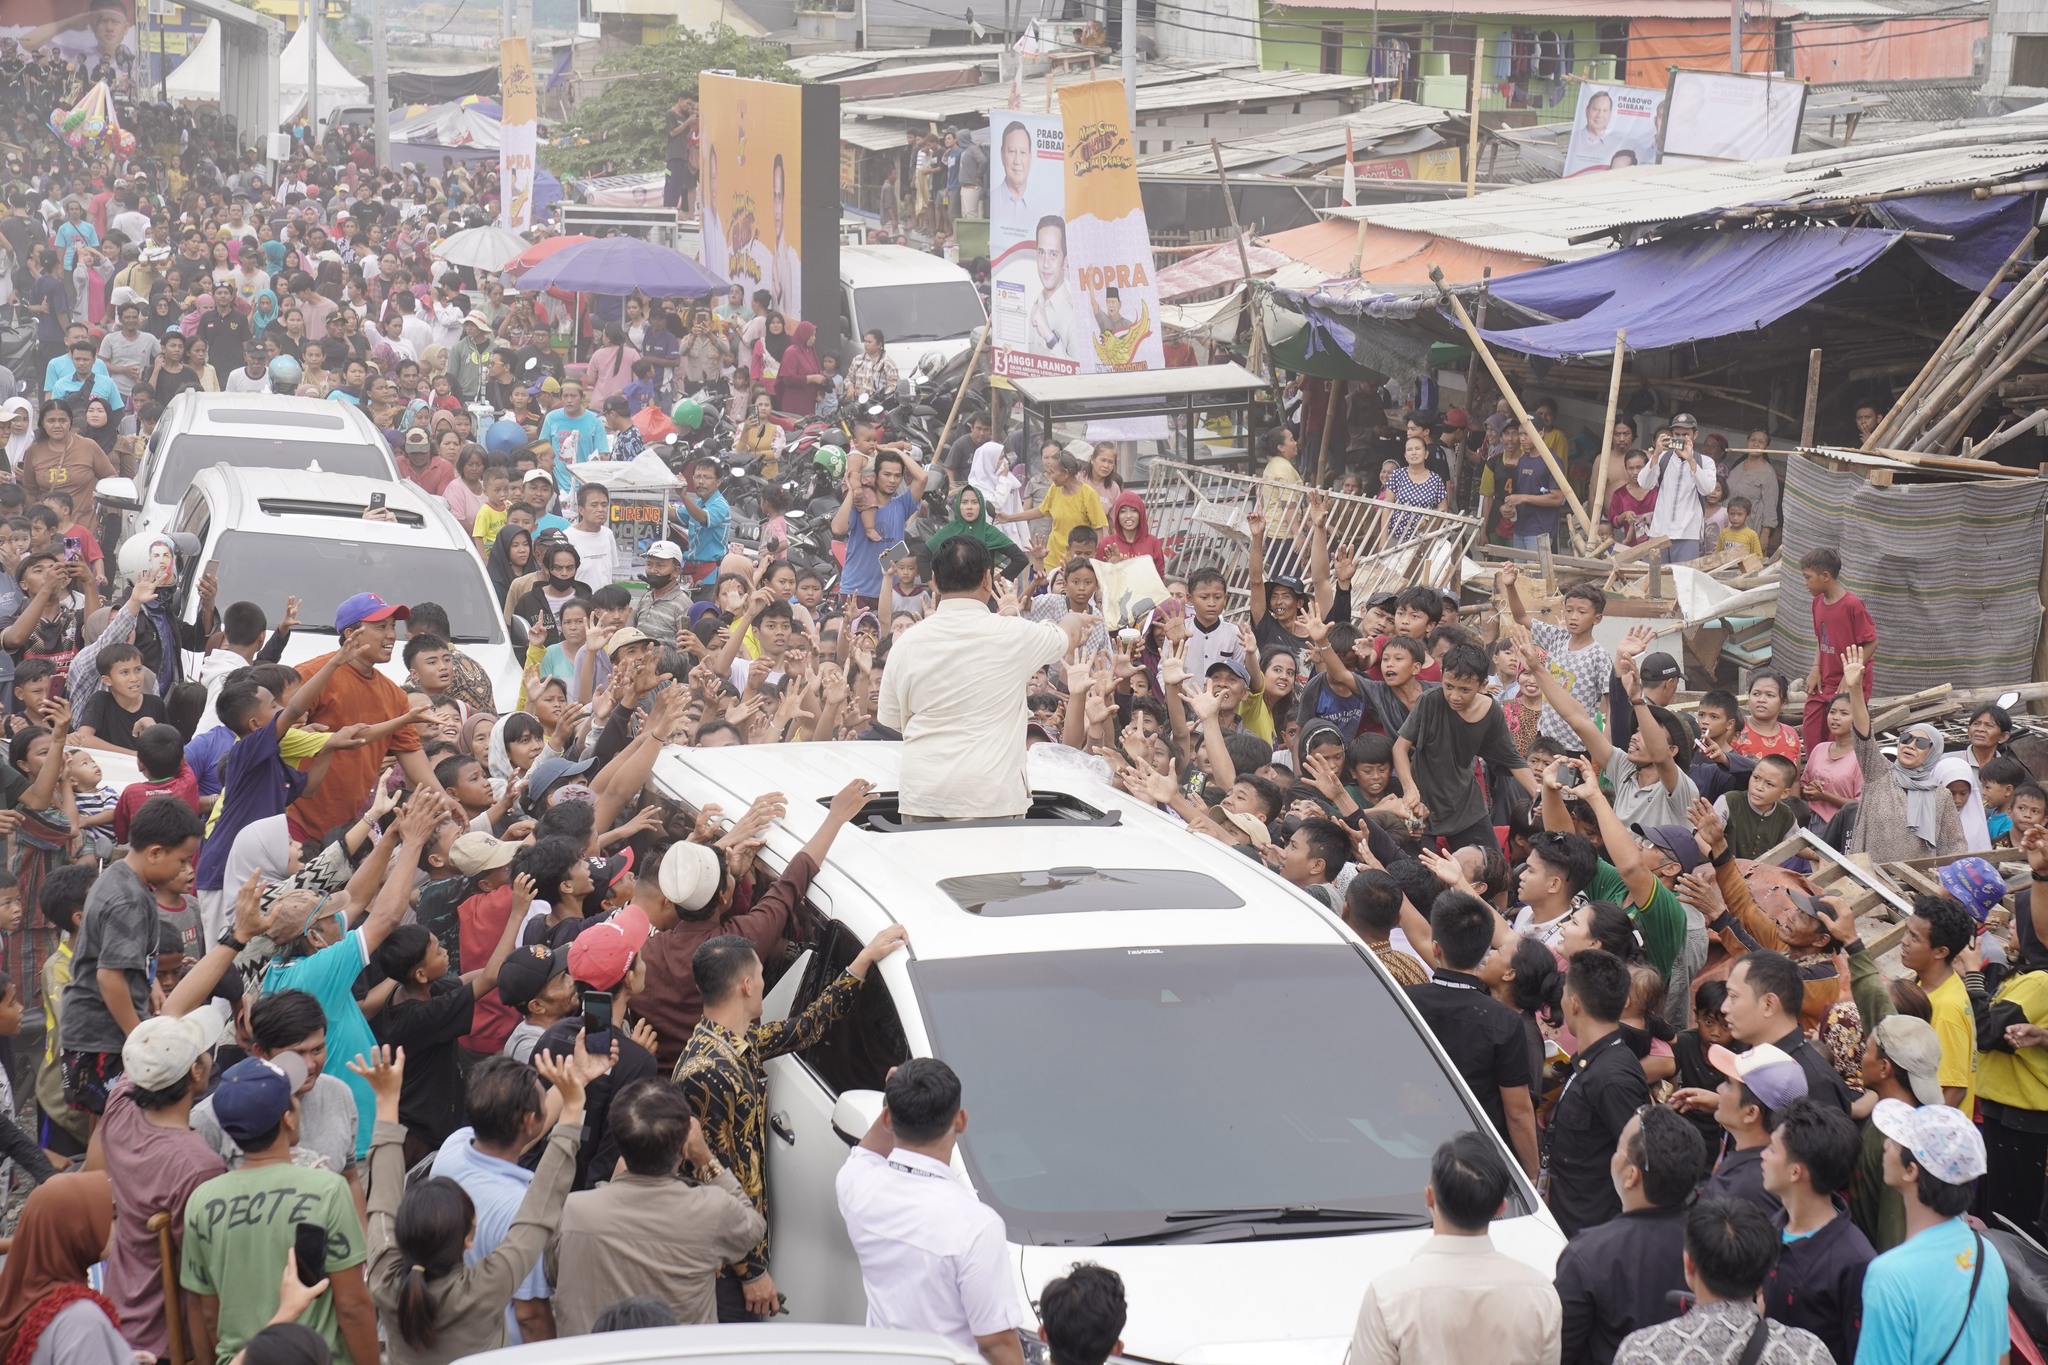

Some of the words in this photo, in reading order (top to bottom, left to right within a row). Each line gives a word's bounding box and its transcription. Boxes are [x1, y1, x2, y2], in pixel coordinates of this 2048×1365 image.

[1617, 102, 1644, 111] GIBRAN
[1618, 95, 1652, 105] PRABOWO
[1391, 167, 1404, 177] Rp
[1078, 263, 1149, 292] KOPRA
[1008, 354, 1034, 368] ANGGI
[1037, 360, 1073, 375] ARANDO
[611, 506, 660, 522] CIRENG
